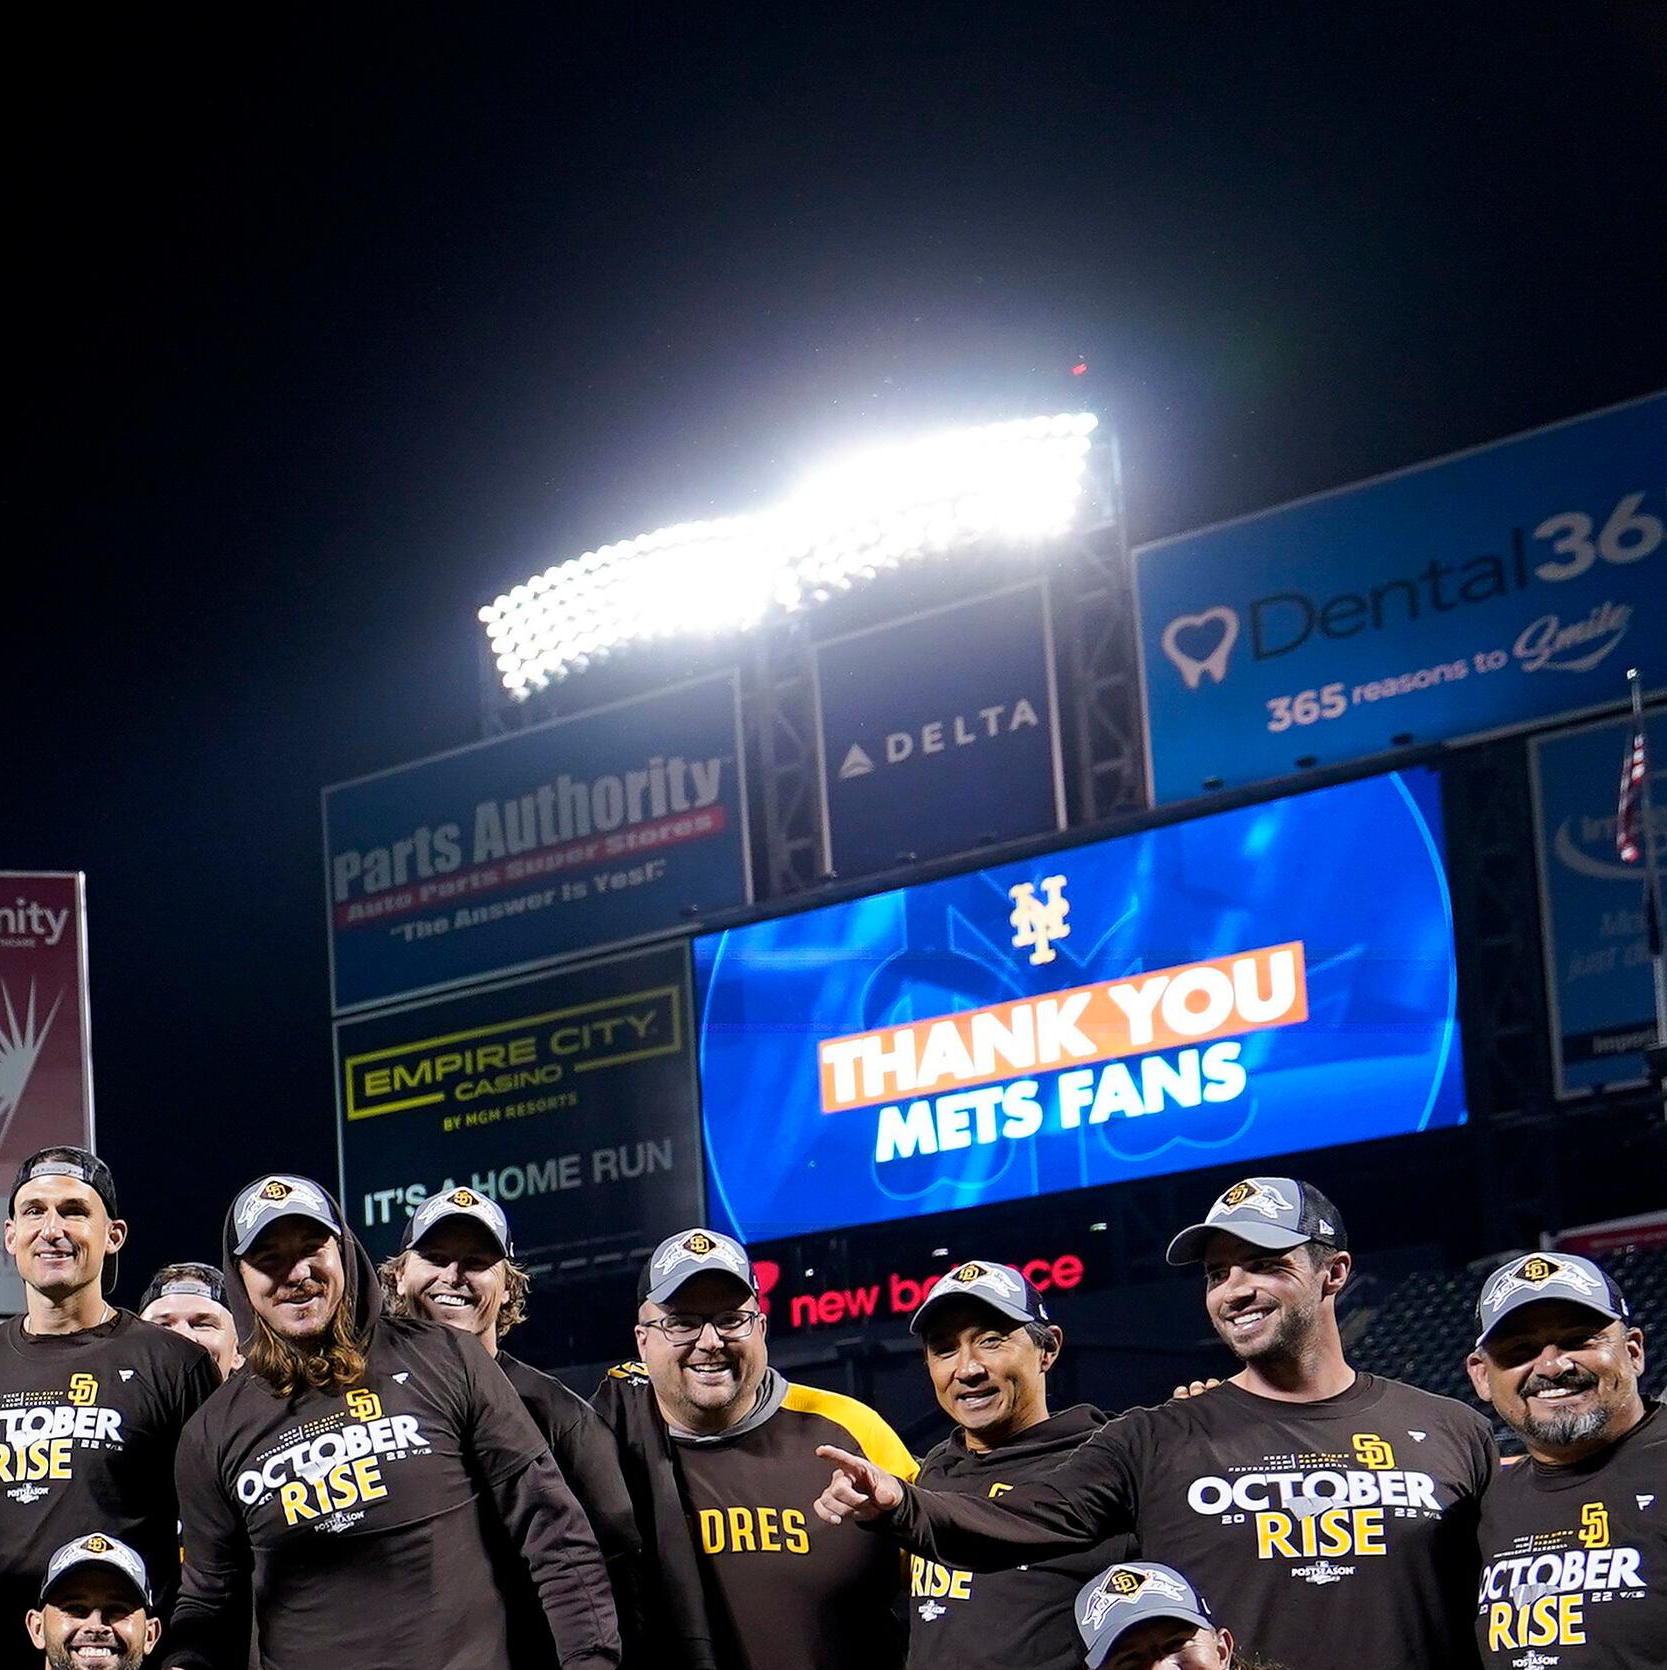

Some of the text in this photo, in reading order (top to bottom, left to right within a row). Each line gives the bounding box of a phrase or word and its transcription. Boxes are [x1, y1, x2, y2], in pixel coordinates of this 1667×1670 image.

[1267, 601, 1633, 732] 365 reasons to Smile
[884, 698, 1039, 764] DELTA
[333, 755, 724, 902] Parts Authority
[346, 814, 713, 923] Auto Parts Super Stores
[454, 888, 554, 930] Answer
[821, 950, 1295, 1104] THANK YOU
[364, 1010, 658, 1097] EMPIRE CITY
[454, 1064, 563, 1102] CASINO
[875, 1041, 1248, 1163] METS FANS
[443, 1092, 578, 1132] BY MGM RESORTS
[364, 1138, 672, 1226] IT'S HOME RUN
[790, 1284, 880, 1328] new
[69, 1373, 99, 1406] SD
[347, 1388, 383, 1422] SD
[81, 1439, 100, 1449] 22
[237, 1413, 432, 1505] OCTOBER
[386, 1448, 407, 1461] 22
[1352, 1434, 1395, 1470] SD
[279, 1455, 390, 1526] RISE
[1187, 1470, 1443, 1516] OCTOBER
[1395, 1508, 1418, 1518] 22
[1221, 1515, 1246, 1525] 20
[1255, 1509, 1389, 1560] RISE
[1578, 1502, 1610, 1549] SD
[1478, 1548, 1647, 1608] OCTOBER
[1591, 1591, 1613, 1602] 22
[1488, 1598, 1587, 1653] RISE
